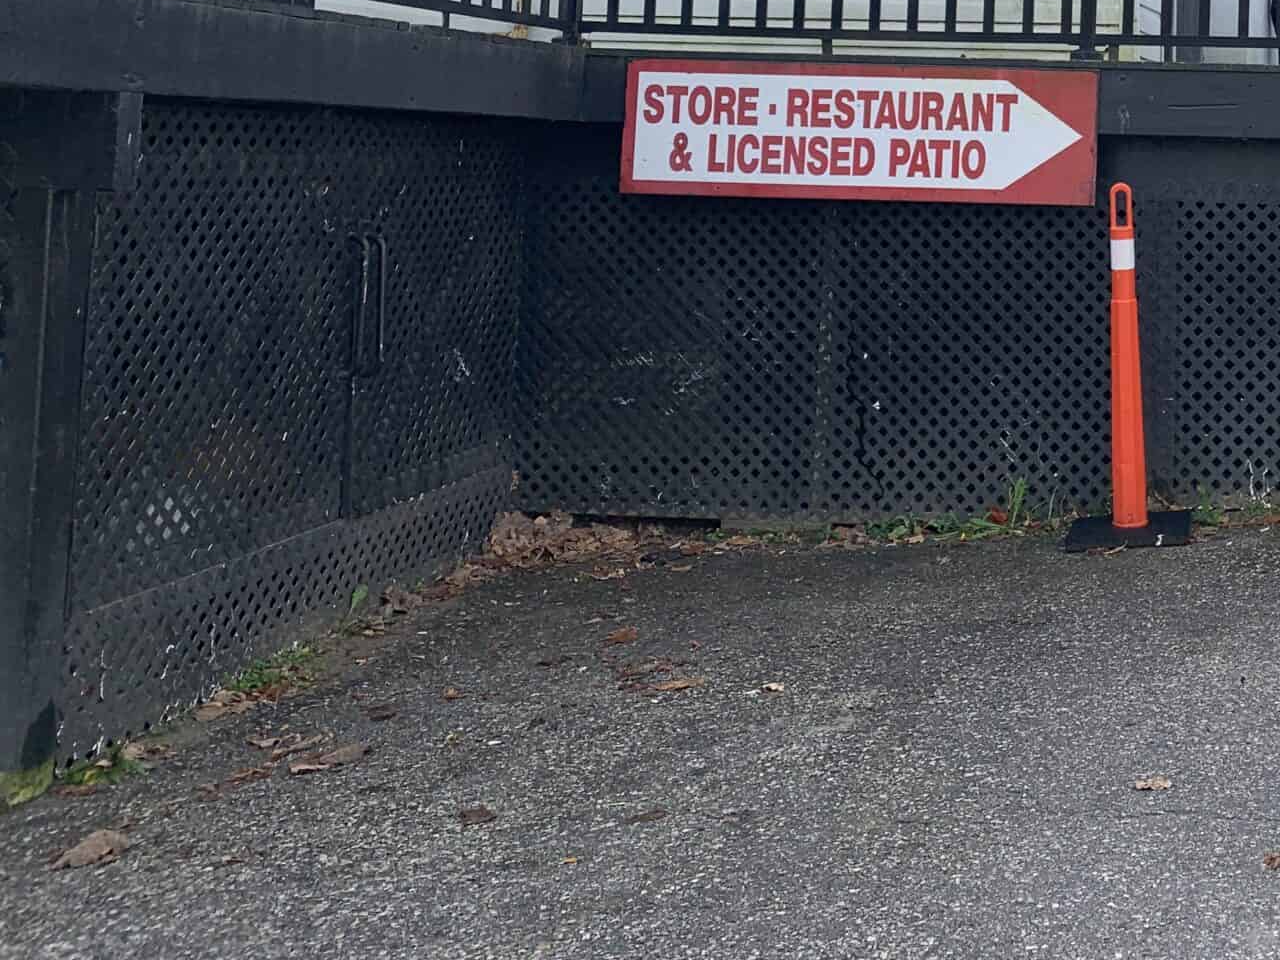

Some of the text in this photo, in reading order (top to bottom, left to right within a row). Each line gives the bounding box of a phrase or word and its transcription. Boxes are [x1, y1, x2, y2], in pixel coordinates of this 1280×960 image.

[643, 84, 760, 126] STORE
[786, 88, 1019, 132] RESTAURANT
[669, 132, 987, 180] & LICENSED PATIO
